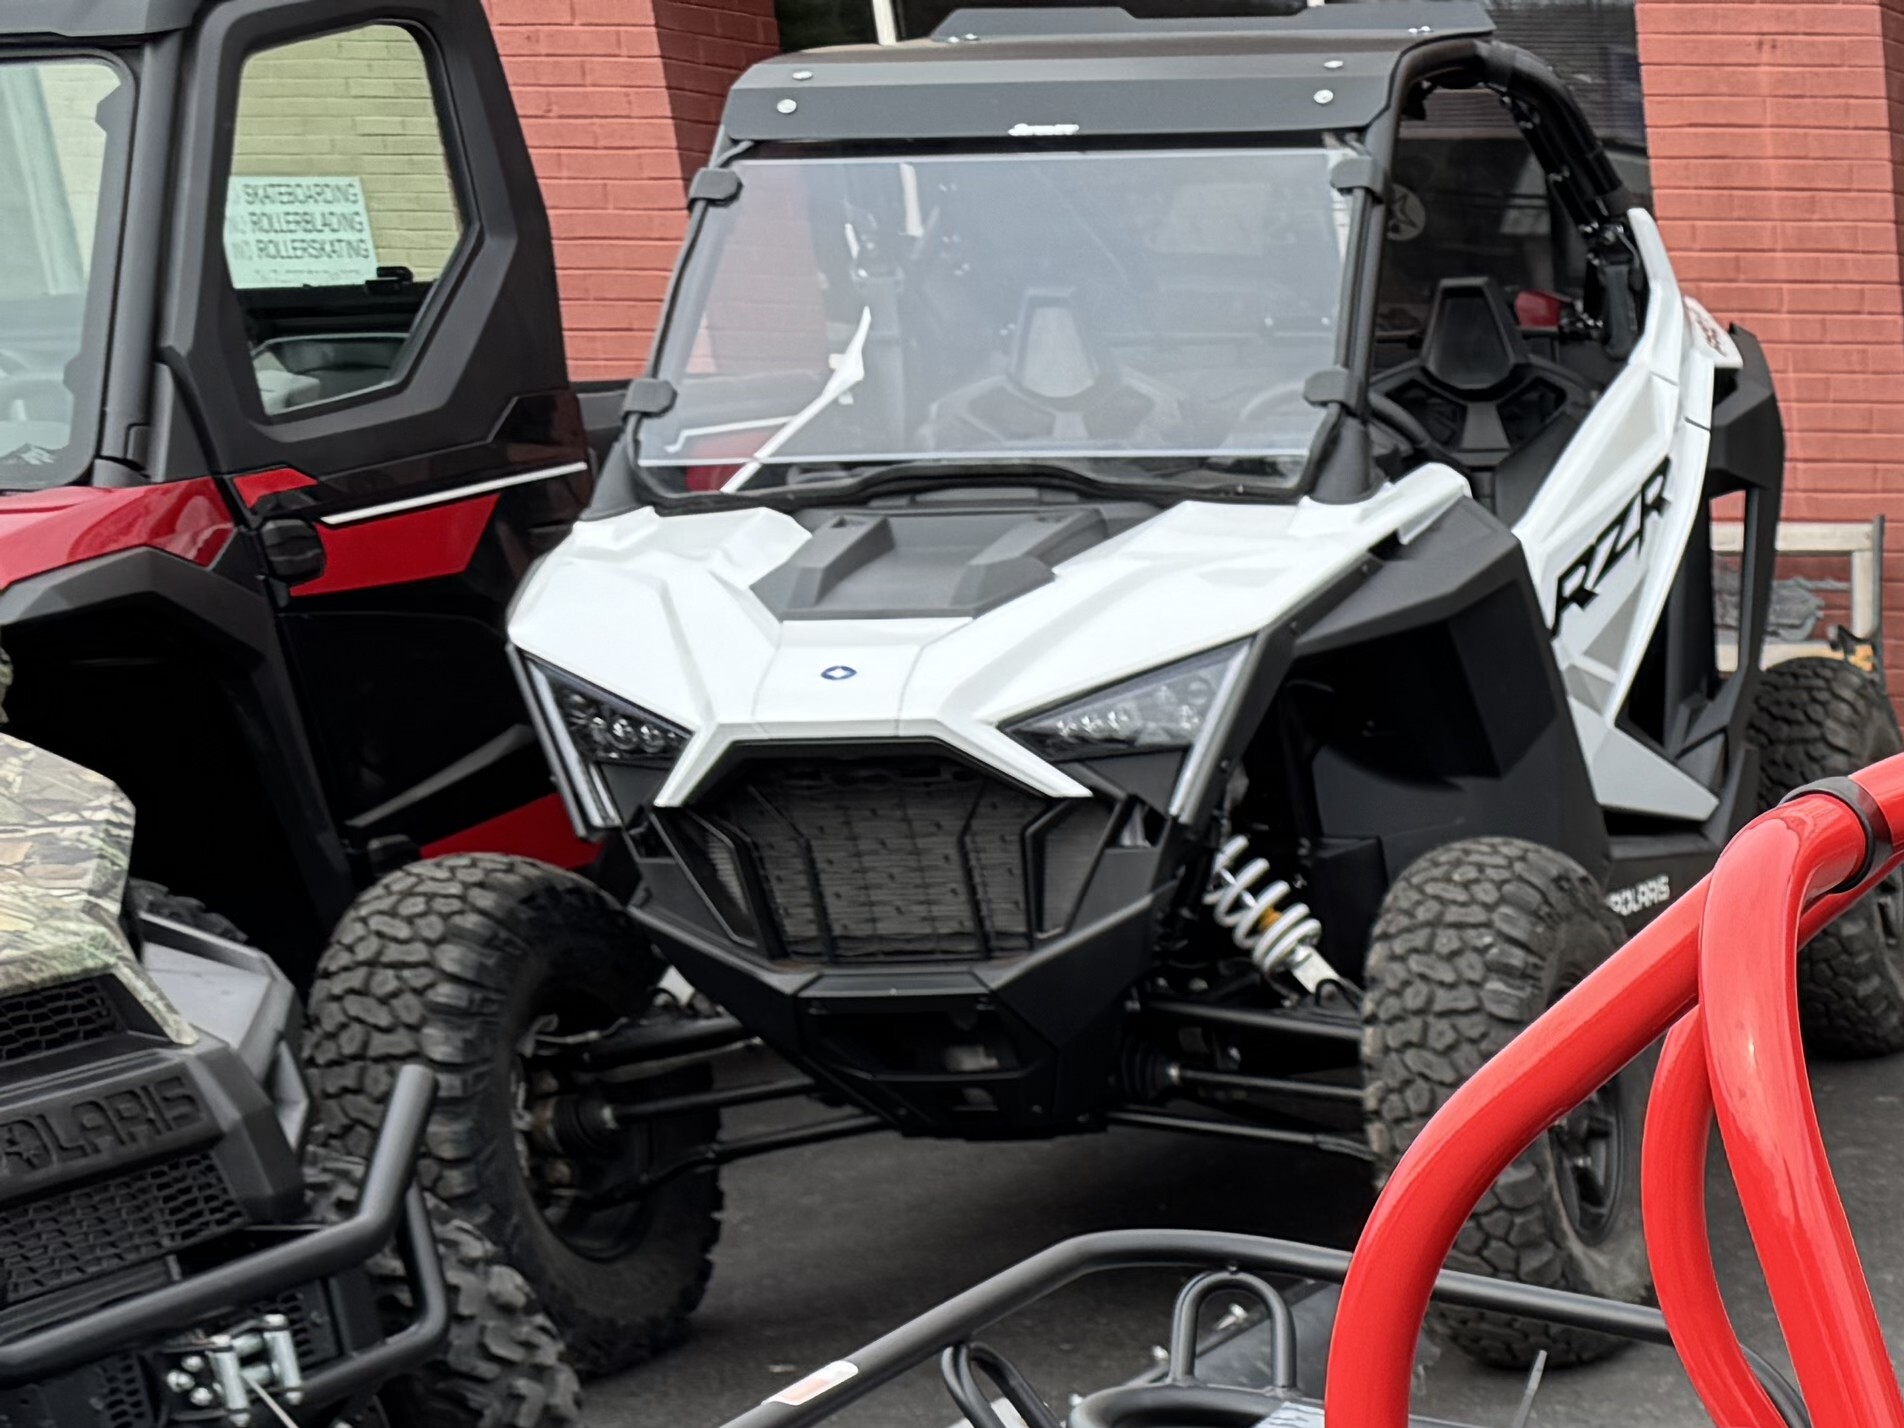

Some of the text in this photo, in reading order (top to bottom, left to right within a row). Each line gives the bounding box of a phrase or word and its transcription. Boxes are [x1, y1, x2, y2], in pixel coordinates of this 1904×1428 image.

[243, 183, 359, 205] SKATEBOARDING
[248, 212, 364, 233] ROLLERBLADING
[255, 239, 370, 260] ROLLERSKATING
[1551, 454, 1671, 638] RZR
[0, 1075, 200, 1170] OLARIS
